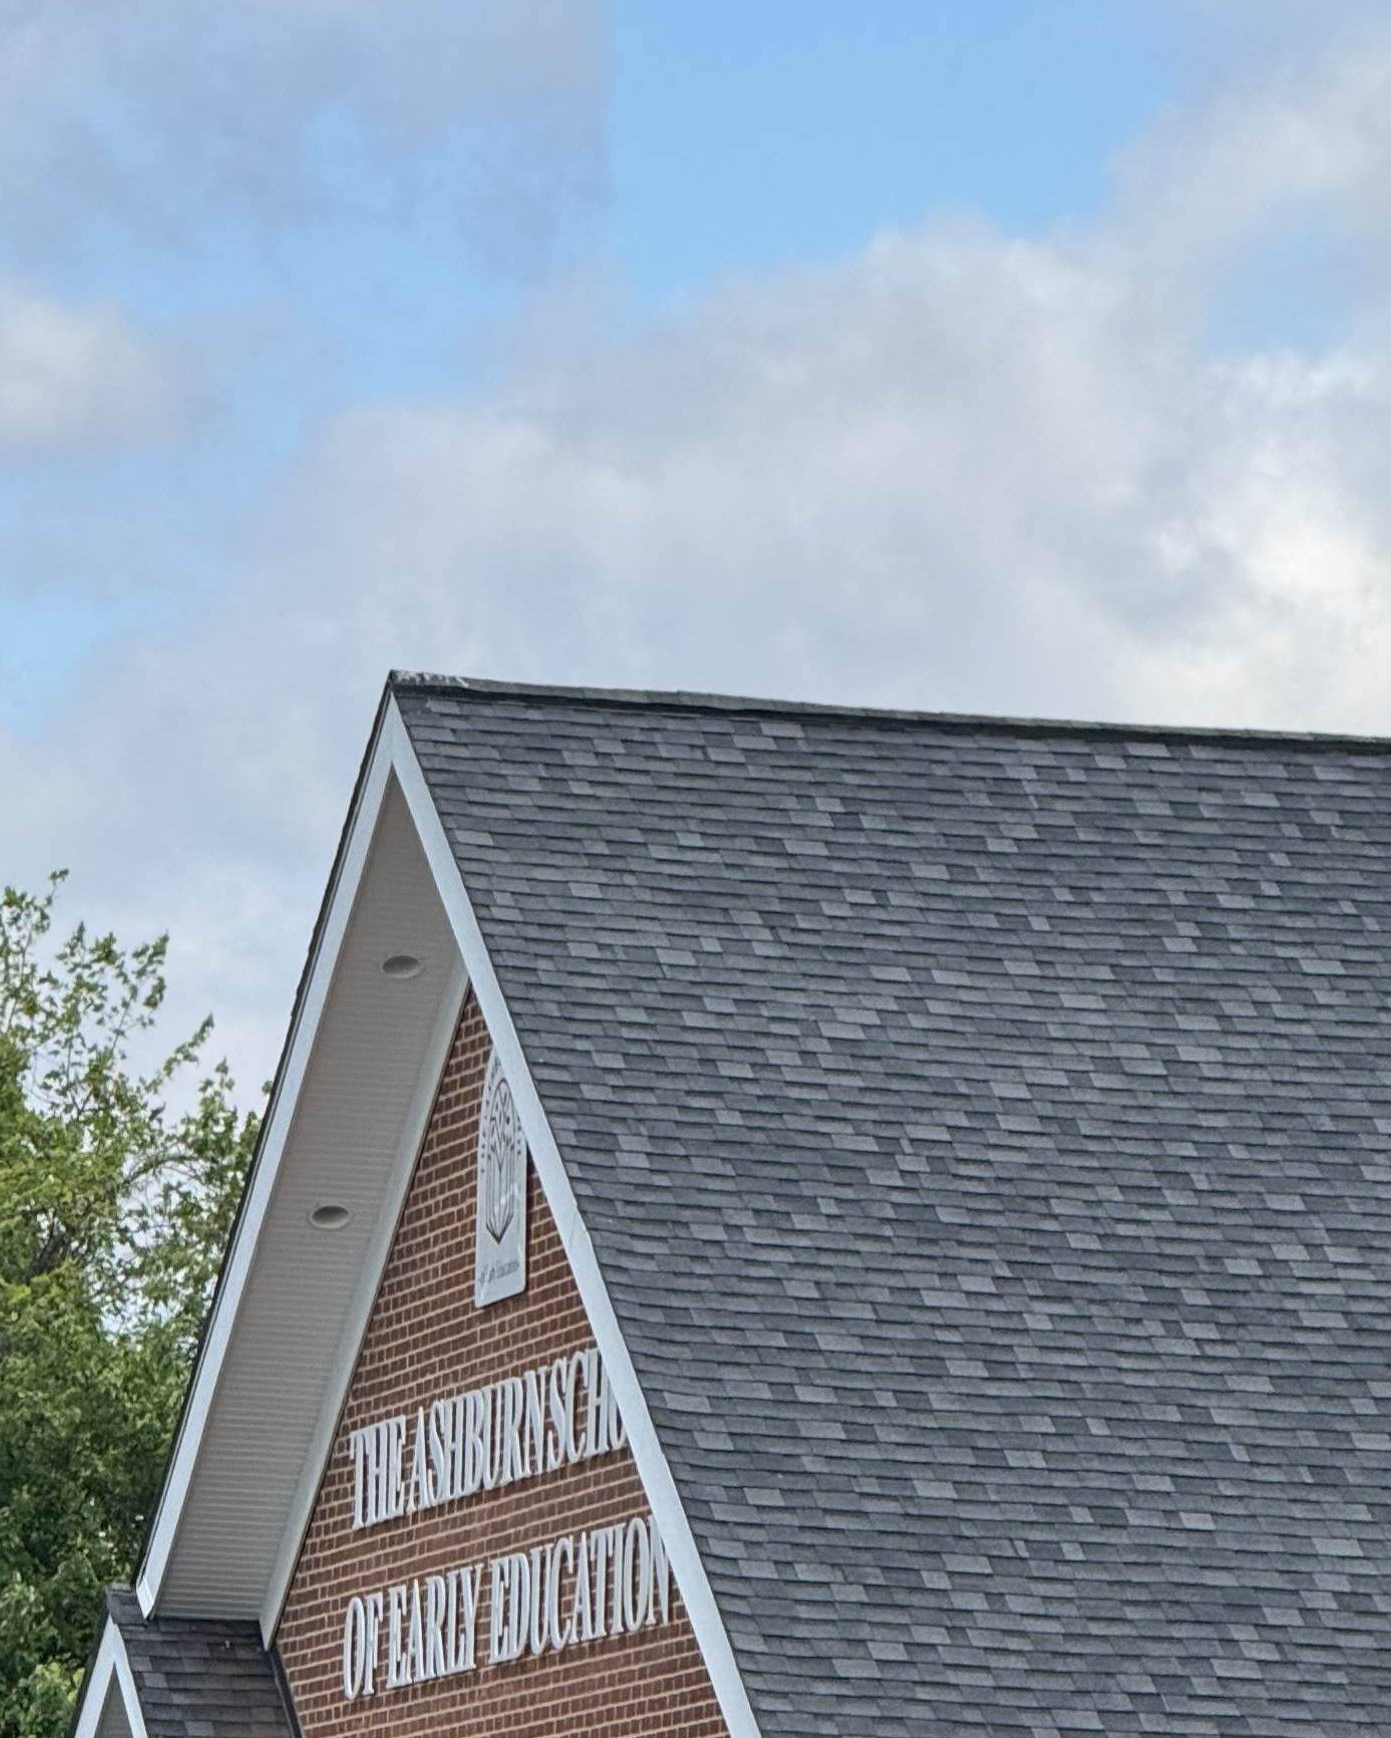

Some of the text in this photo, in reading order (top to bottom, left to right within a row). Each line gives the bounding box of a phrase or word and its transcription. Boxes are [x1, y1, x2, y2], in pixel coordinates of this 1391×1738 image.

[350, 1415, 406, 1530] THE
[406, 1365, 552, 1513] ASHBURN
[343, 1515, 672, 1700] OF EARLY EDUCATION
